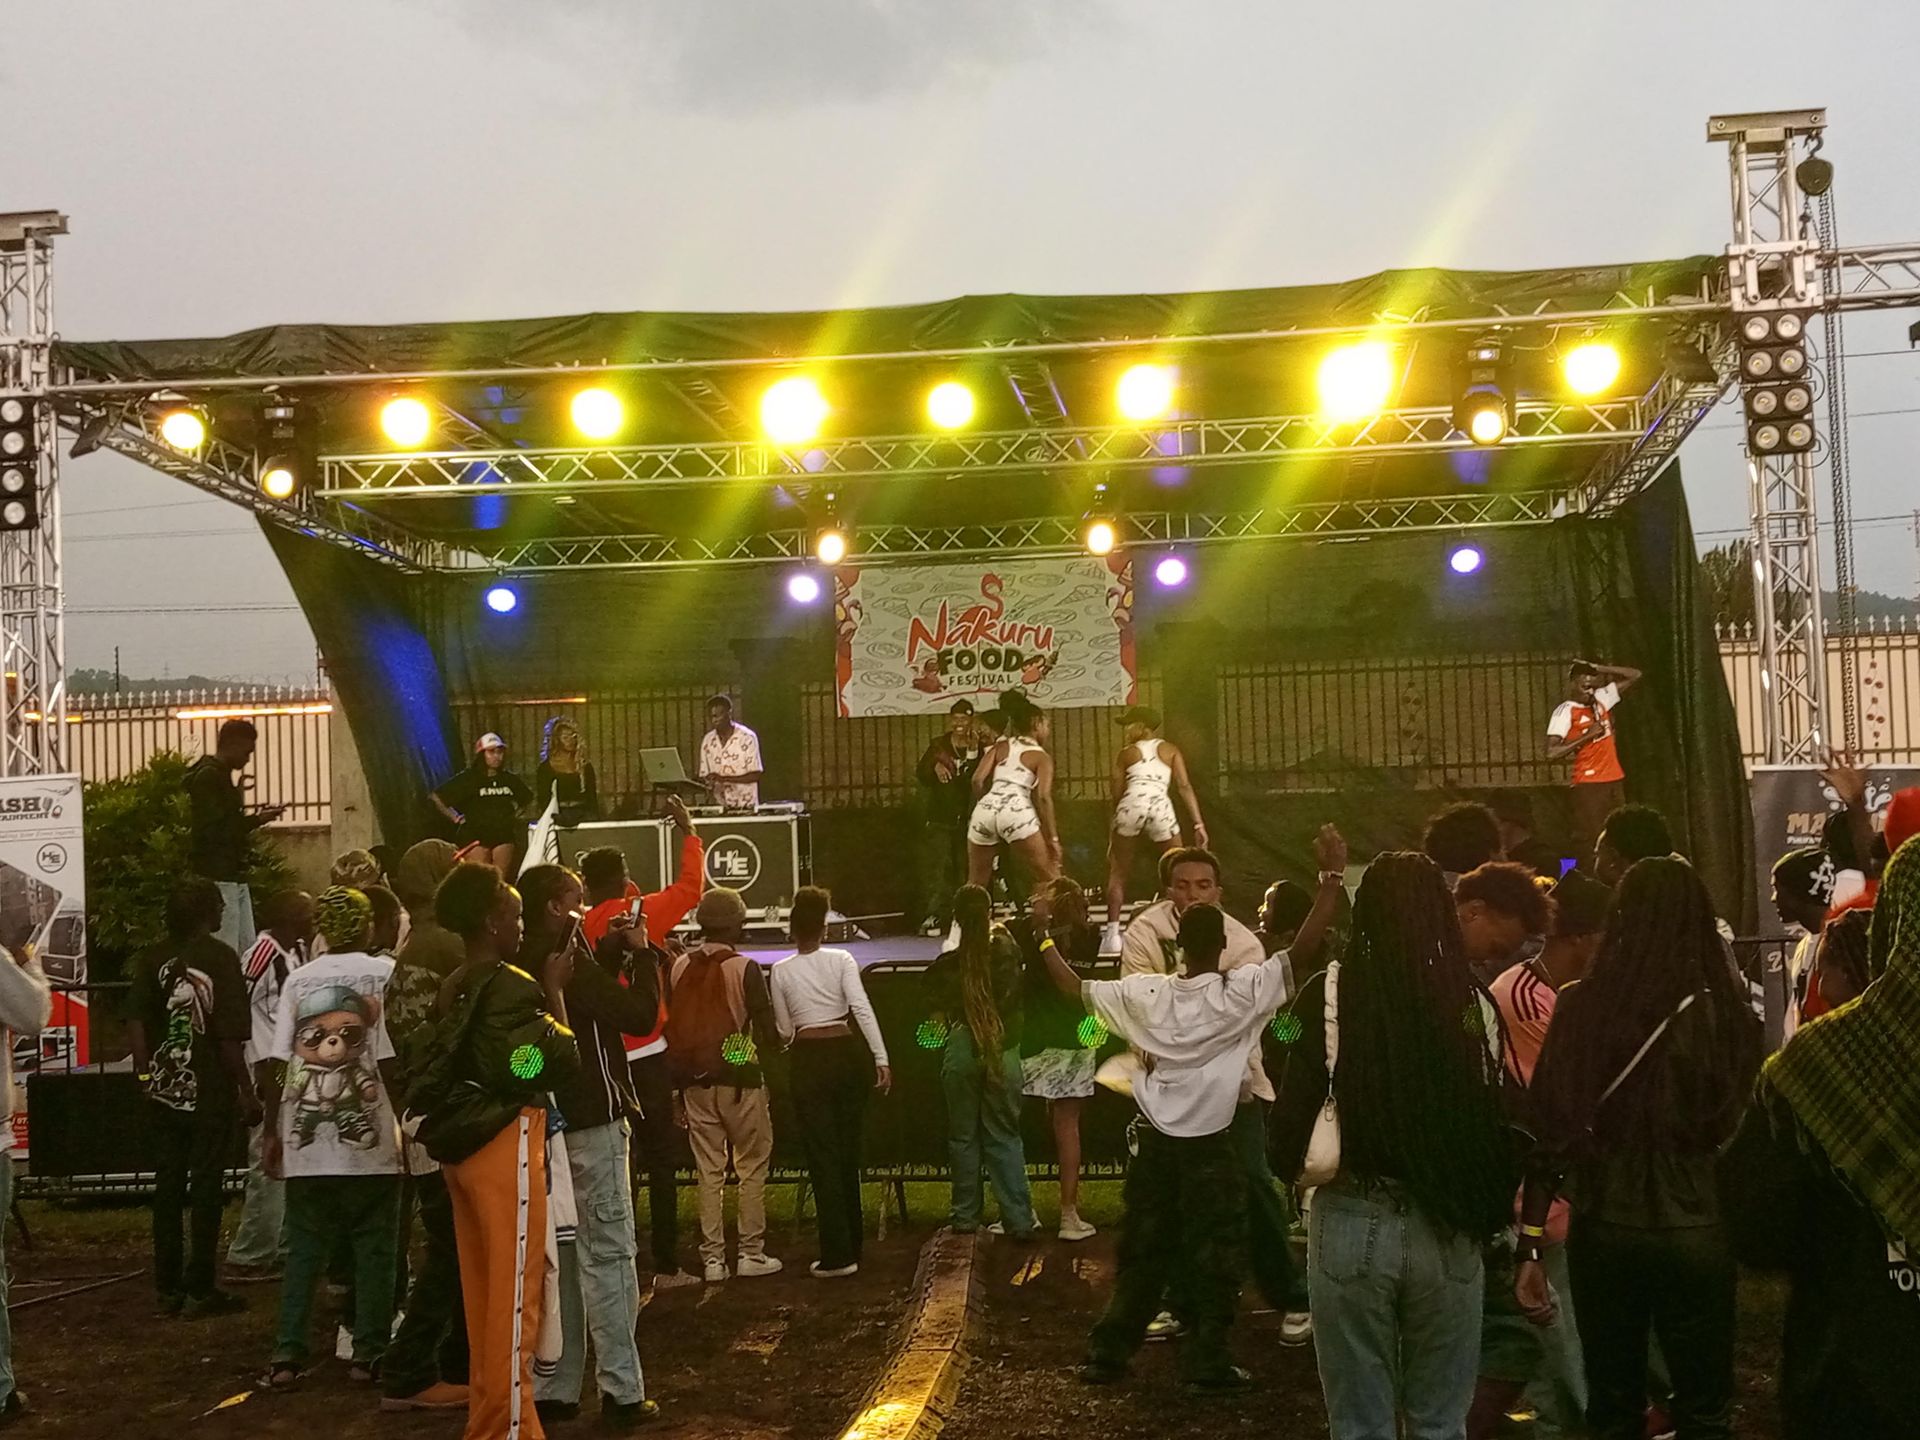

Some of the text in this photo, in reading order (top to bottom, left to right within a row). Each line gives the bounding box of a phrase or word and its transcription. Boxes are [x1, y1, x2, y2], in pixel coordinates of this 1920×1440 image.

[906, 600, 1055, 664] Nakuru
[936, 648, 1025, 676] FOOD
[949, 673, 1014, 688] FESTIVAL
[713, 850, 750, 876] HE
